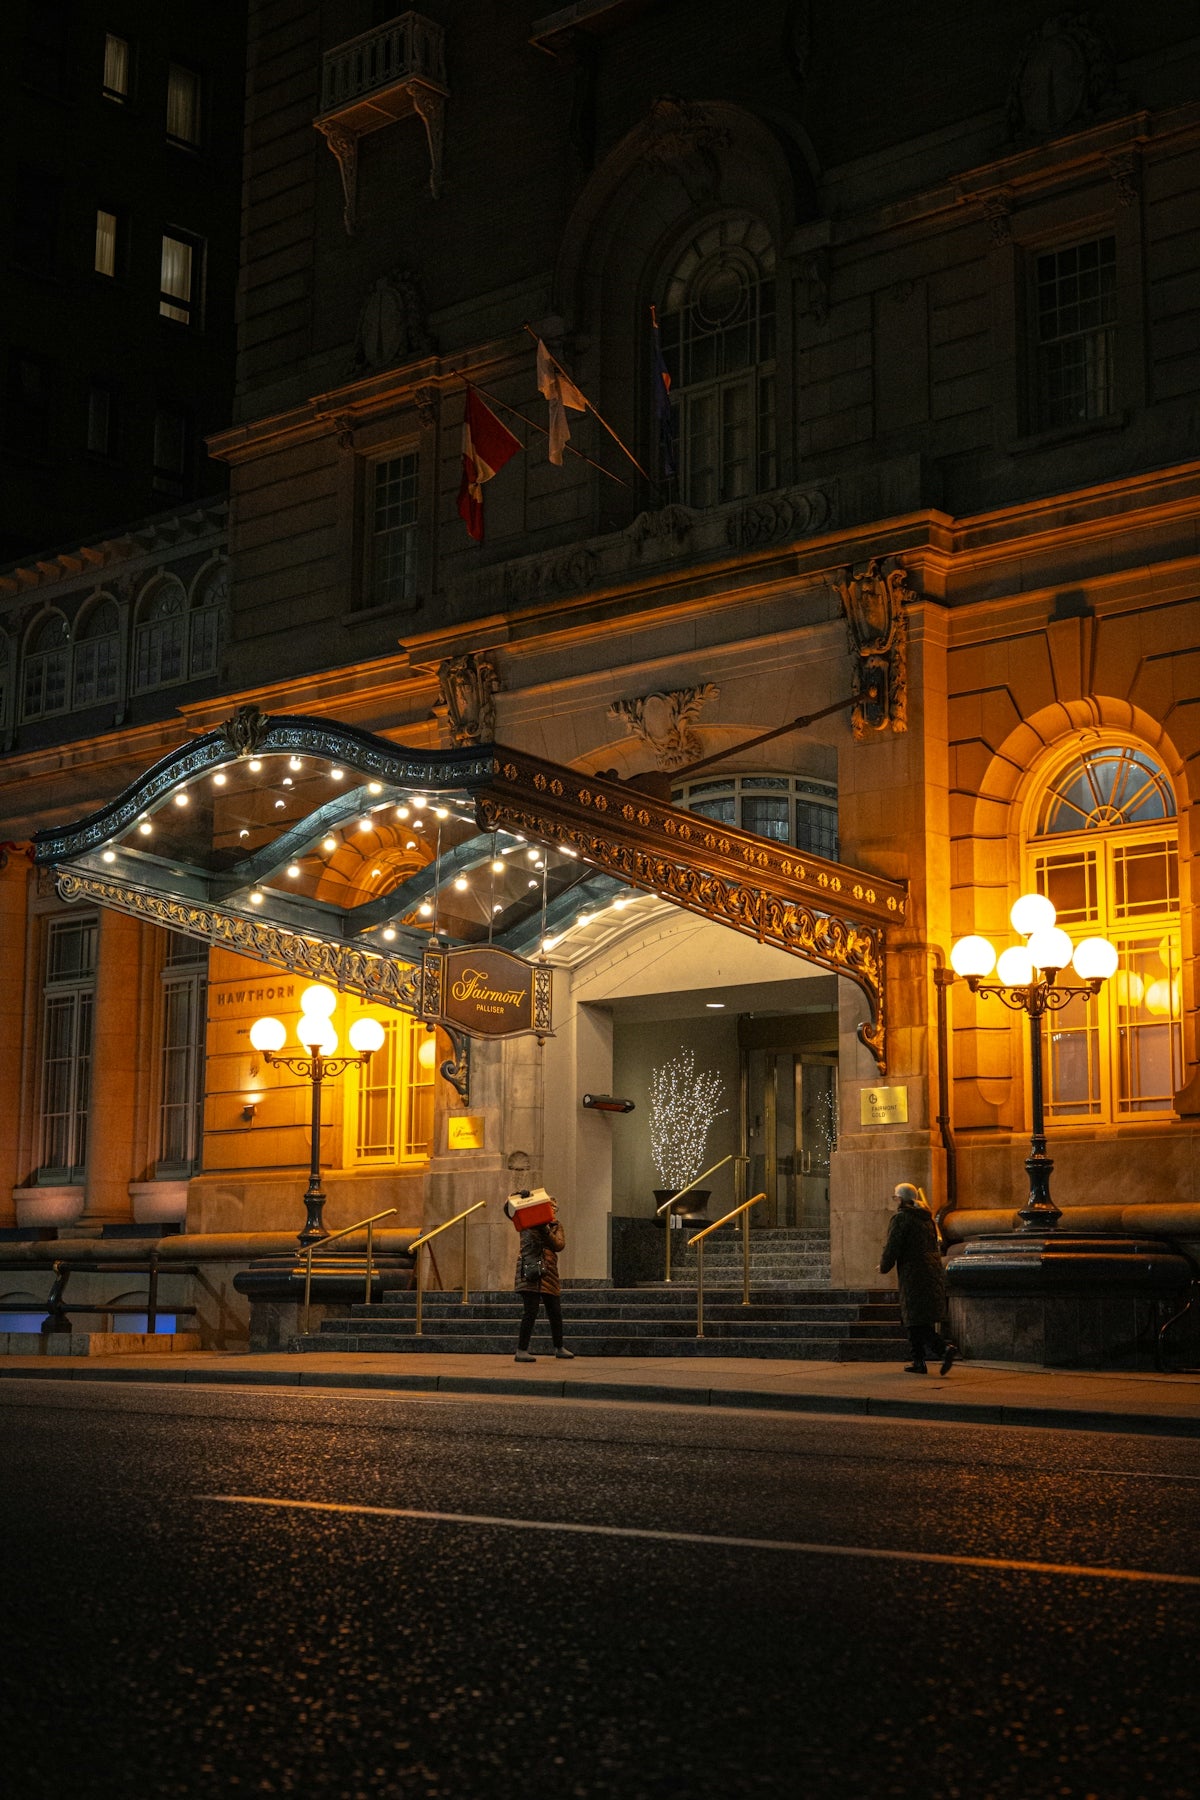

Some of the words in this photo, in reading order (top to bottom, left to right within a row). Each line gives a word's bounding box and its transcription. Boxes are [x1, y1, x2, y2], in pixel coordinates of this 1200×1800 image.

[217, 985, 294, 1005] HAWTHORN
[452, 968, 528, 1007] Fairmont
[476, 1003, 505, 1014] PALLISER
